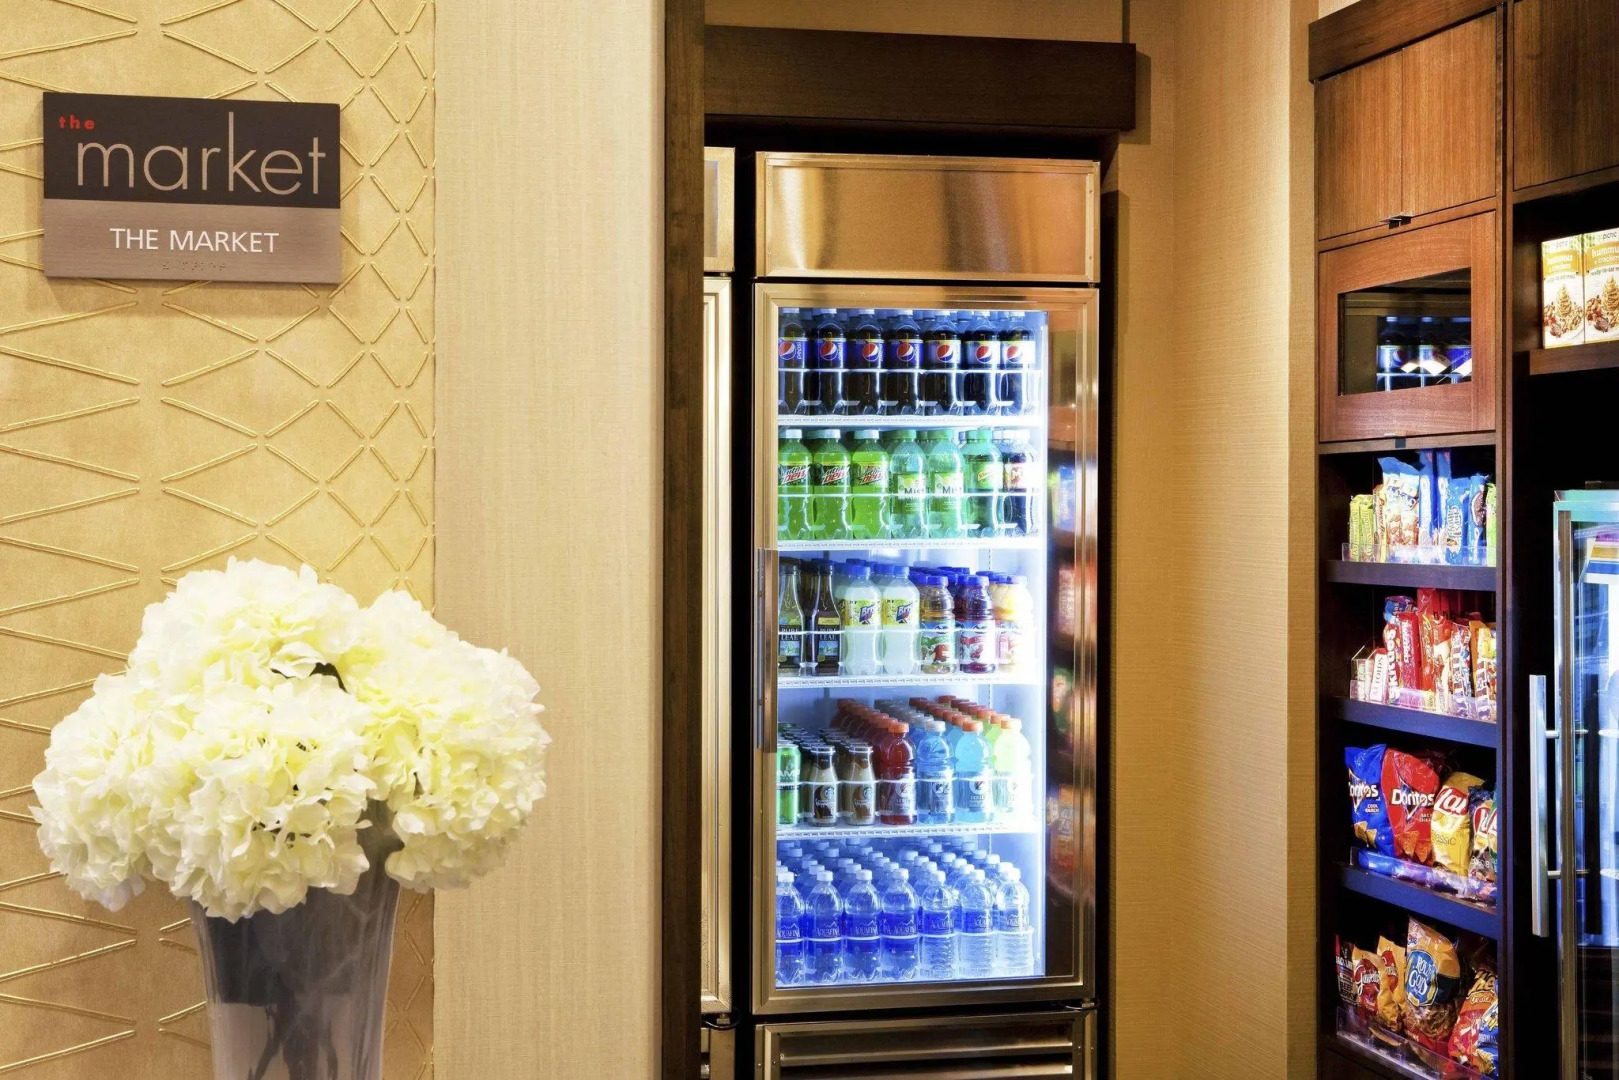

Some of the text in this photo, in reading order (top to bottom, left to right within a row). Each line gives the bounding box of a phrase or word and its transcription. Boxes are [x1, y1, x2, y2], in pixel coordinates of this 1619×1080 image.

[58, 115, 95, 130] the
[77, 111, 326, 195] market
[110, 228, 279, 253] THE MARKET
[1348, 781, 1379, 798] oritos
[1391, 788, 1435, 807] Doritos
